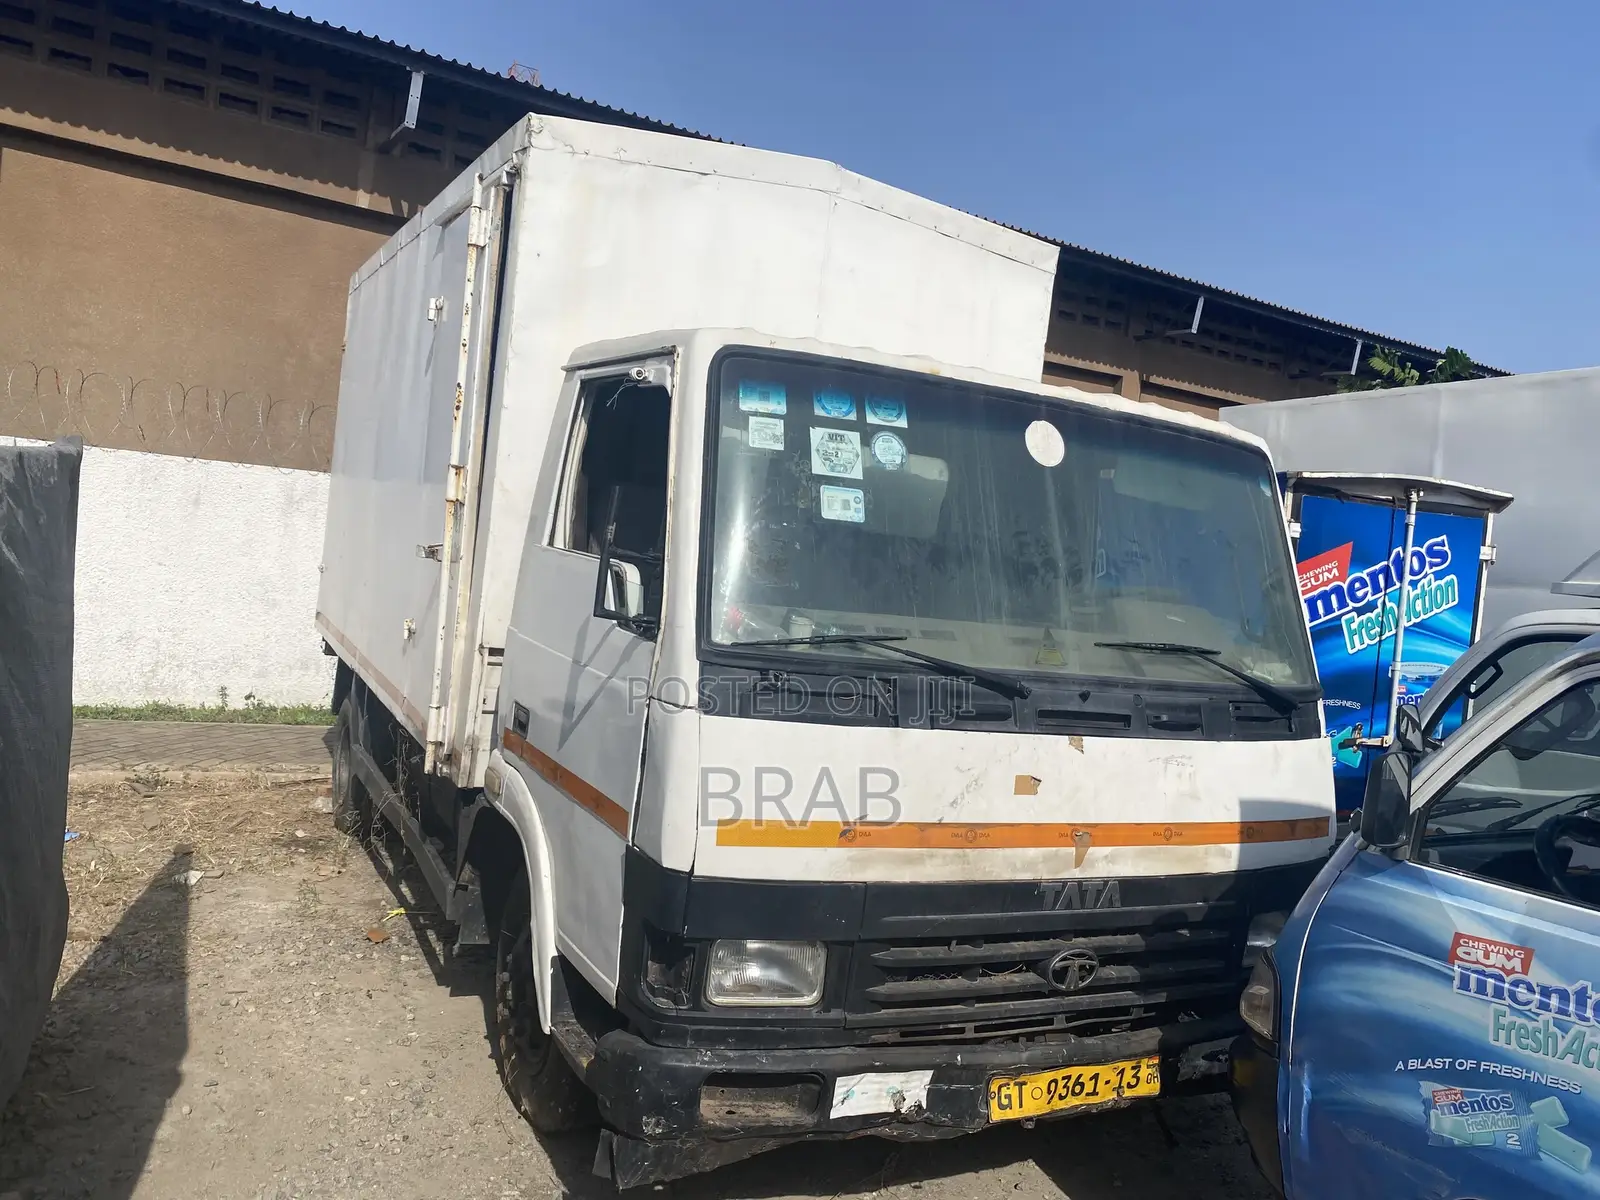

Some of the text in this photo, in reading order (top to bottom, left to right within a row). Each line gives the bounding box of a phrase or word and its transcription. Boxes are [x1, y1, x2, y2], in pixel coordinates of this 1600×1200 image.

[1299, 560, 1339, 581] CHEWING
[1300, 568, 1340, 591] GUM
[1303, 537, 1450, 624] mentos
[1343, 597, 1399, 650] Fresh
[1322, 699, 1361, 710] FRESHNESS
[1040, 881, 1122, 910] TATA
[1456, 946, 1523, 973] GUM
[1459, 938, 1525, 959] CHEWING
[1492, 1006, 1559, 1058] Fresh
[1395, 1058, 1582, 1095] A BLAST OF FRESHNESS
[997, 1081, 1028, 1111] GT
[1433, 1089, 1462, 1097] CHEWING
[1434, 1093, 1462, 1102] GUM
[1438, 1093, 1514, 1117] mentos
[1465, 1115, 1489, 1132] Fresh
[1506, 1132, 1521, 1147] 2
